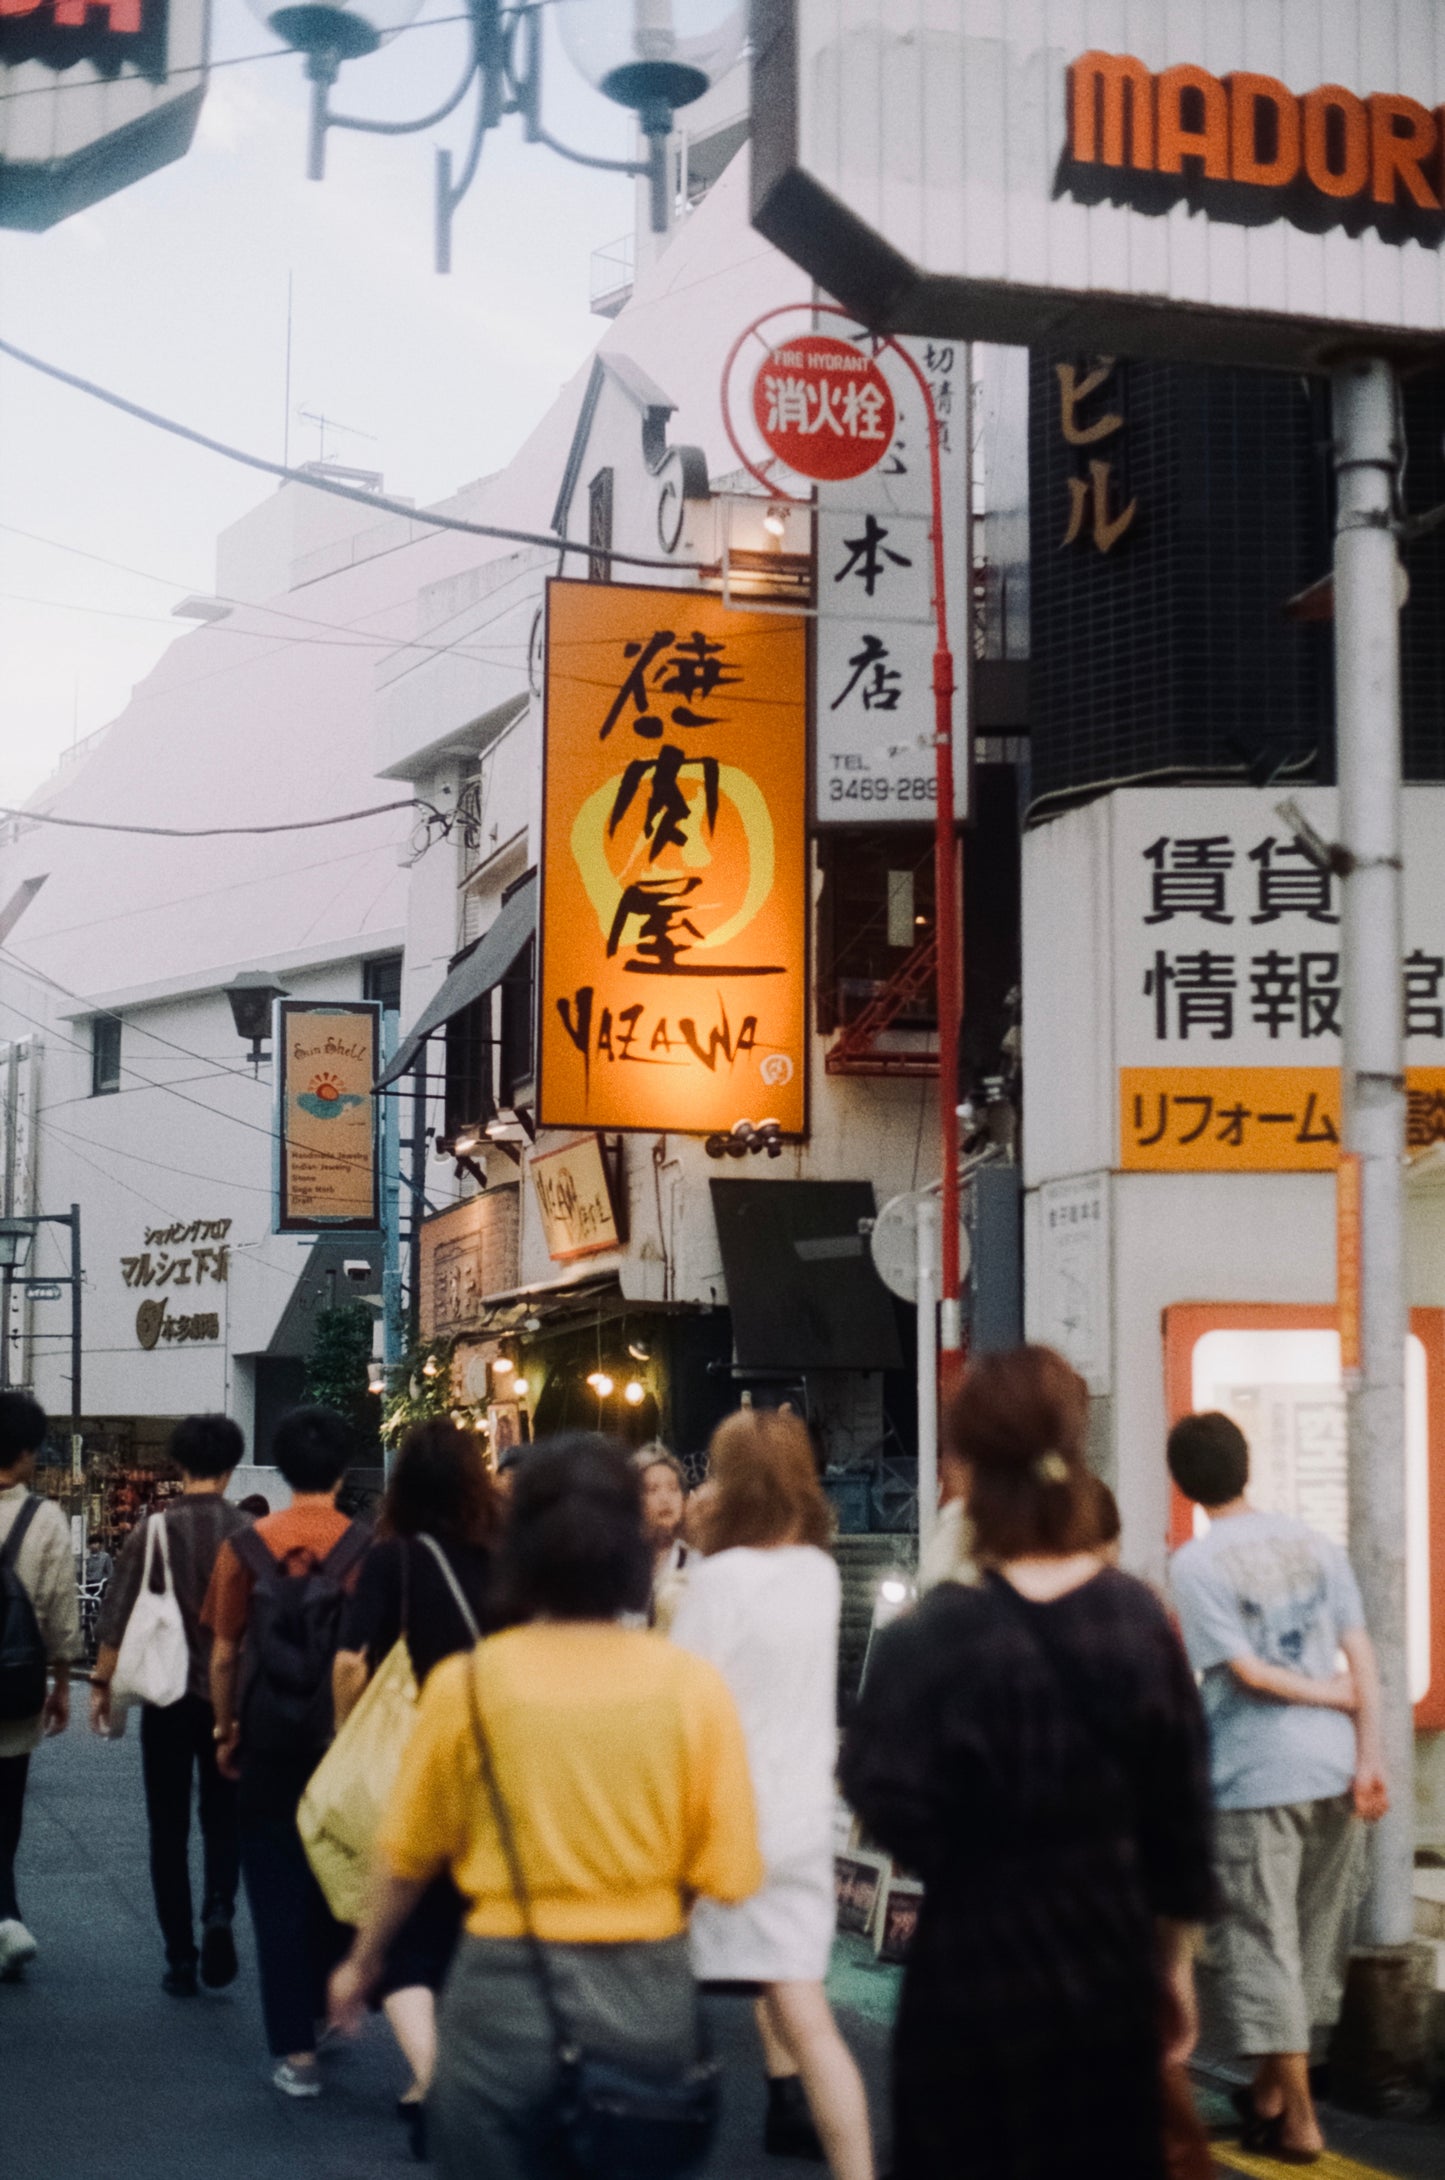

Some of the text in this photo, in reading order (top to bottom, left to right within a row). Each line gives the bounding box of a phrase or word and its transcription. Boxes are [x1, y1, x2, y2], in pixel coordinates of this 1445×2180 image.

[1067, 49, 1445, 212] MADOR
[773, 350, 870, 373] FIRE HYDRANT
[763, 375, 887, 440] 消火栓
[829, 753, 871, 771] TEL
[829, 778, 937, 801] 3469-289
[293, 1036, 367, 1063] Sun Shell
[556, 986, 772, 1098] YAZAWA
